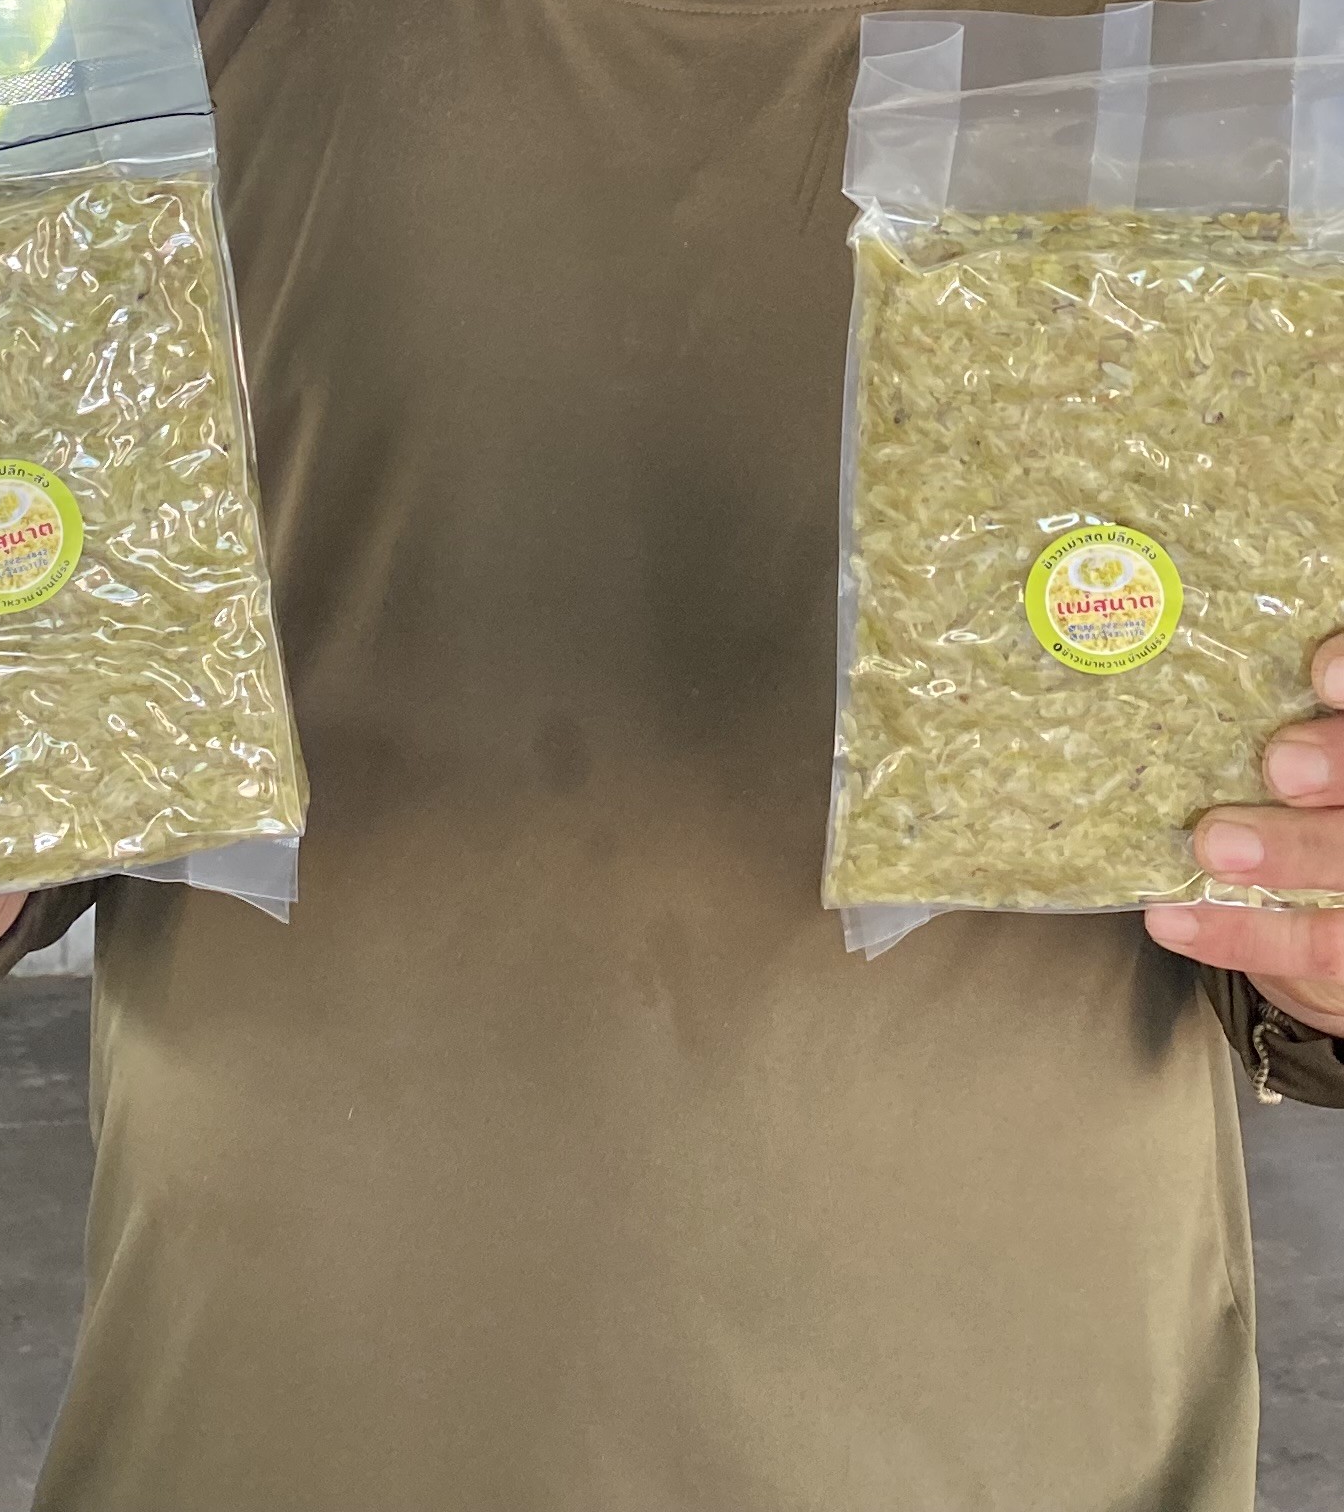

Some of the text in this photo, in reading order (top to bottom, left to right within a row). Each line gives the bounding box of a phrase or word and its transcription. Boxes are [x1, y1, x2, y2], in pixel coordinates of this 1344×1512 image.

[1043, 531, 1157, 570] ข้าวเม่าสด ปลีก-ส่ง
